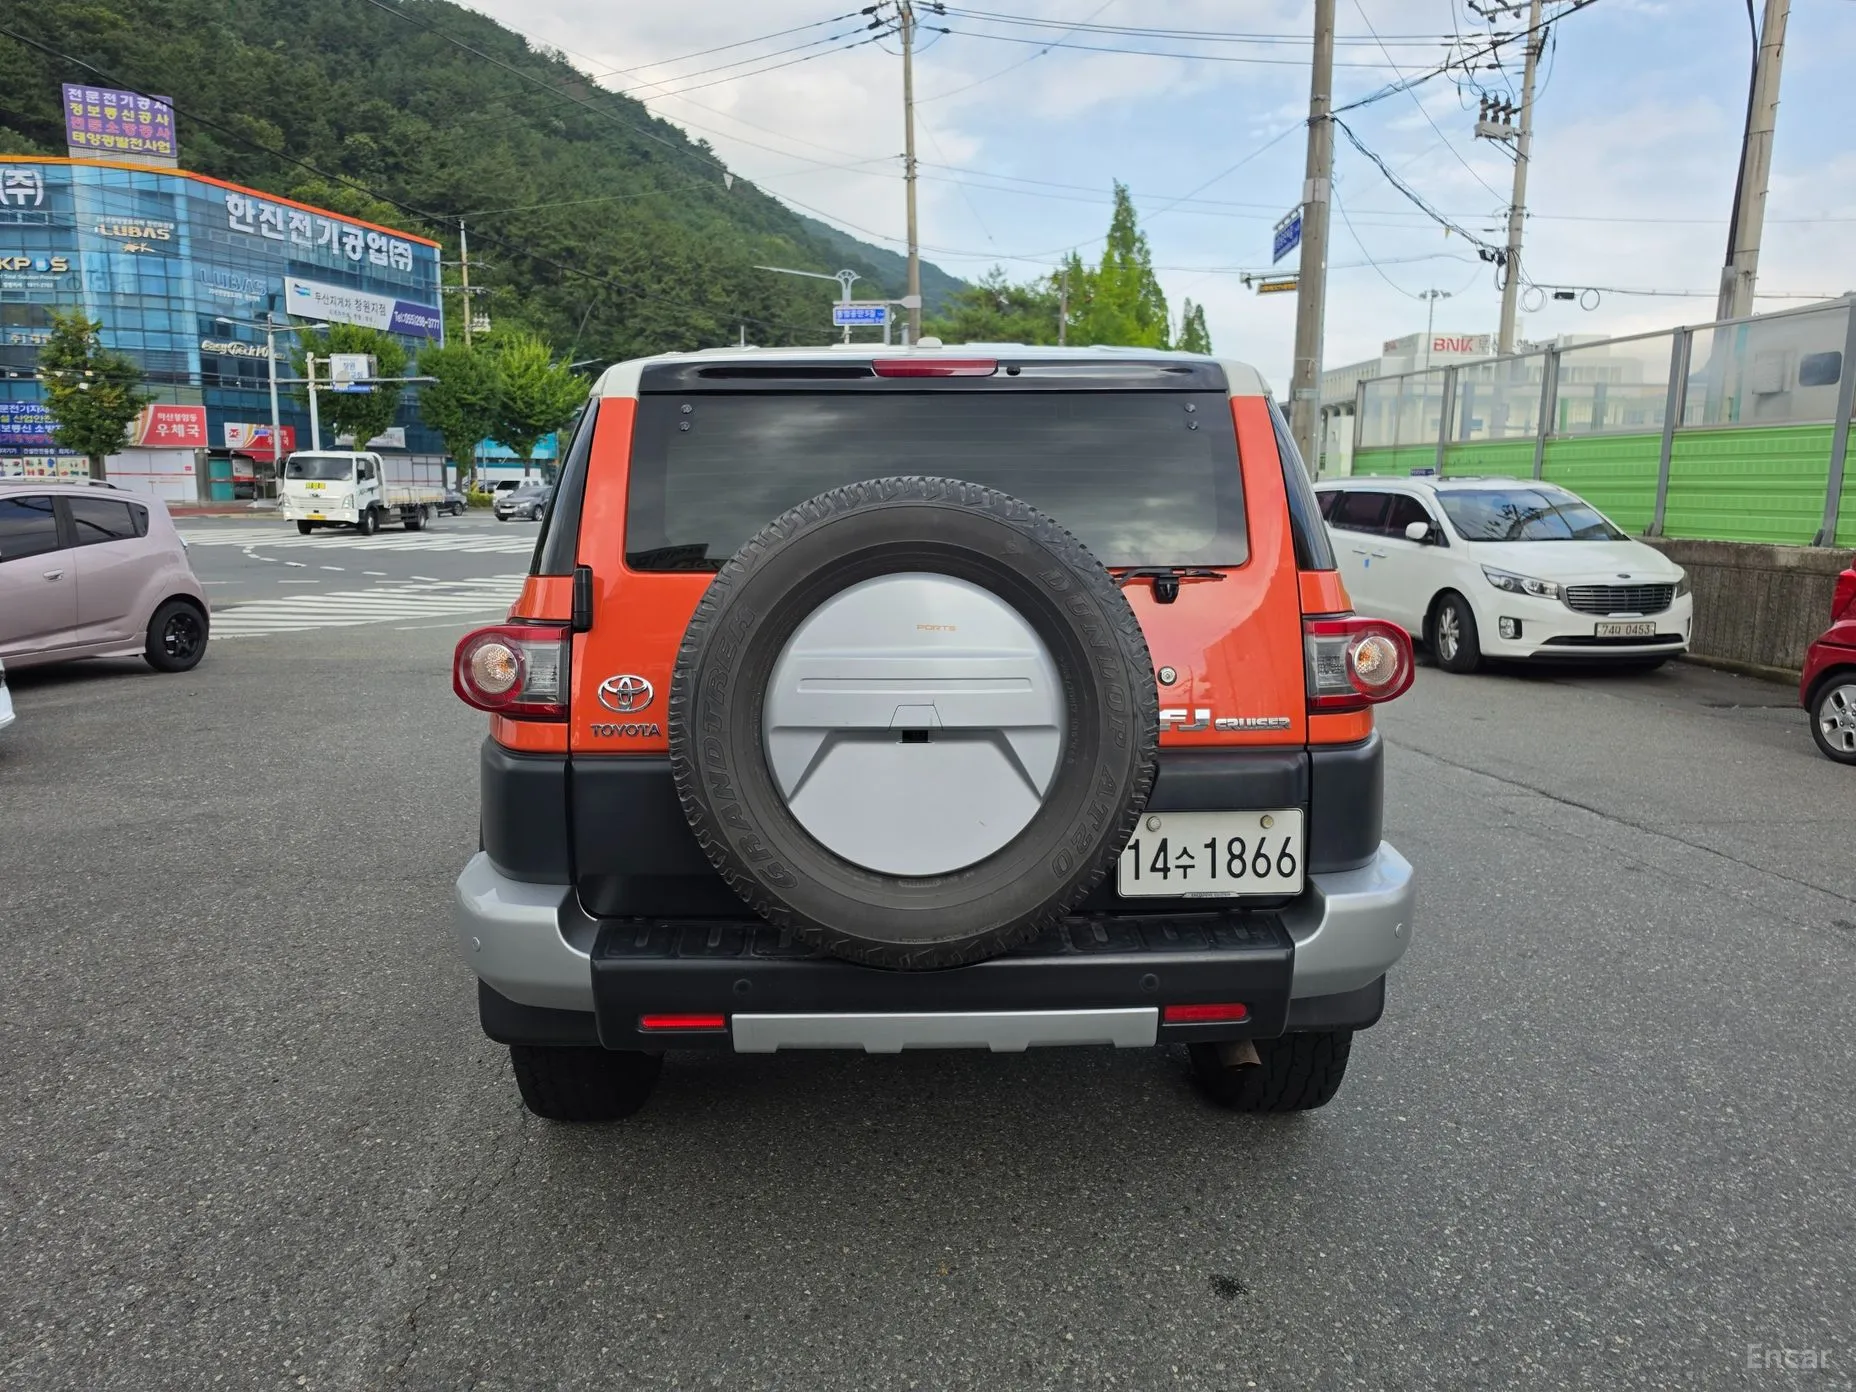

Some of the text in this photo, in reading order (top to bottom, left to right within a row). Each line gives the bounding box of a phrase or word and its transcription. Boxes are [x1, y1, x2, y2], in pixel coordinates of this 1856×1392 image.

[99, 224, 171, 240] LUBAS
[1432, 337, 1474, 353] BNK
[155, 423, 201, 438] 우체국
[1159, 708, 1292, 732] FJ CRUISER
[590, 723, 662, 738] TOYOTA
